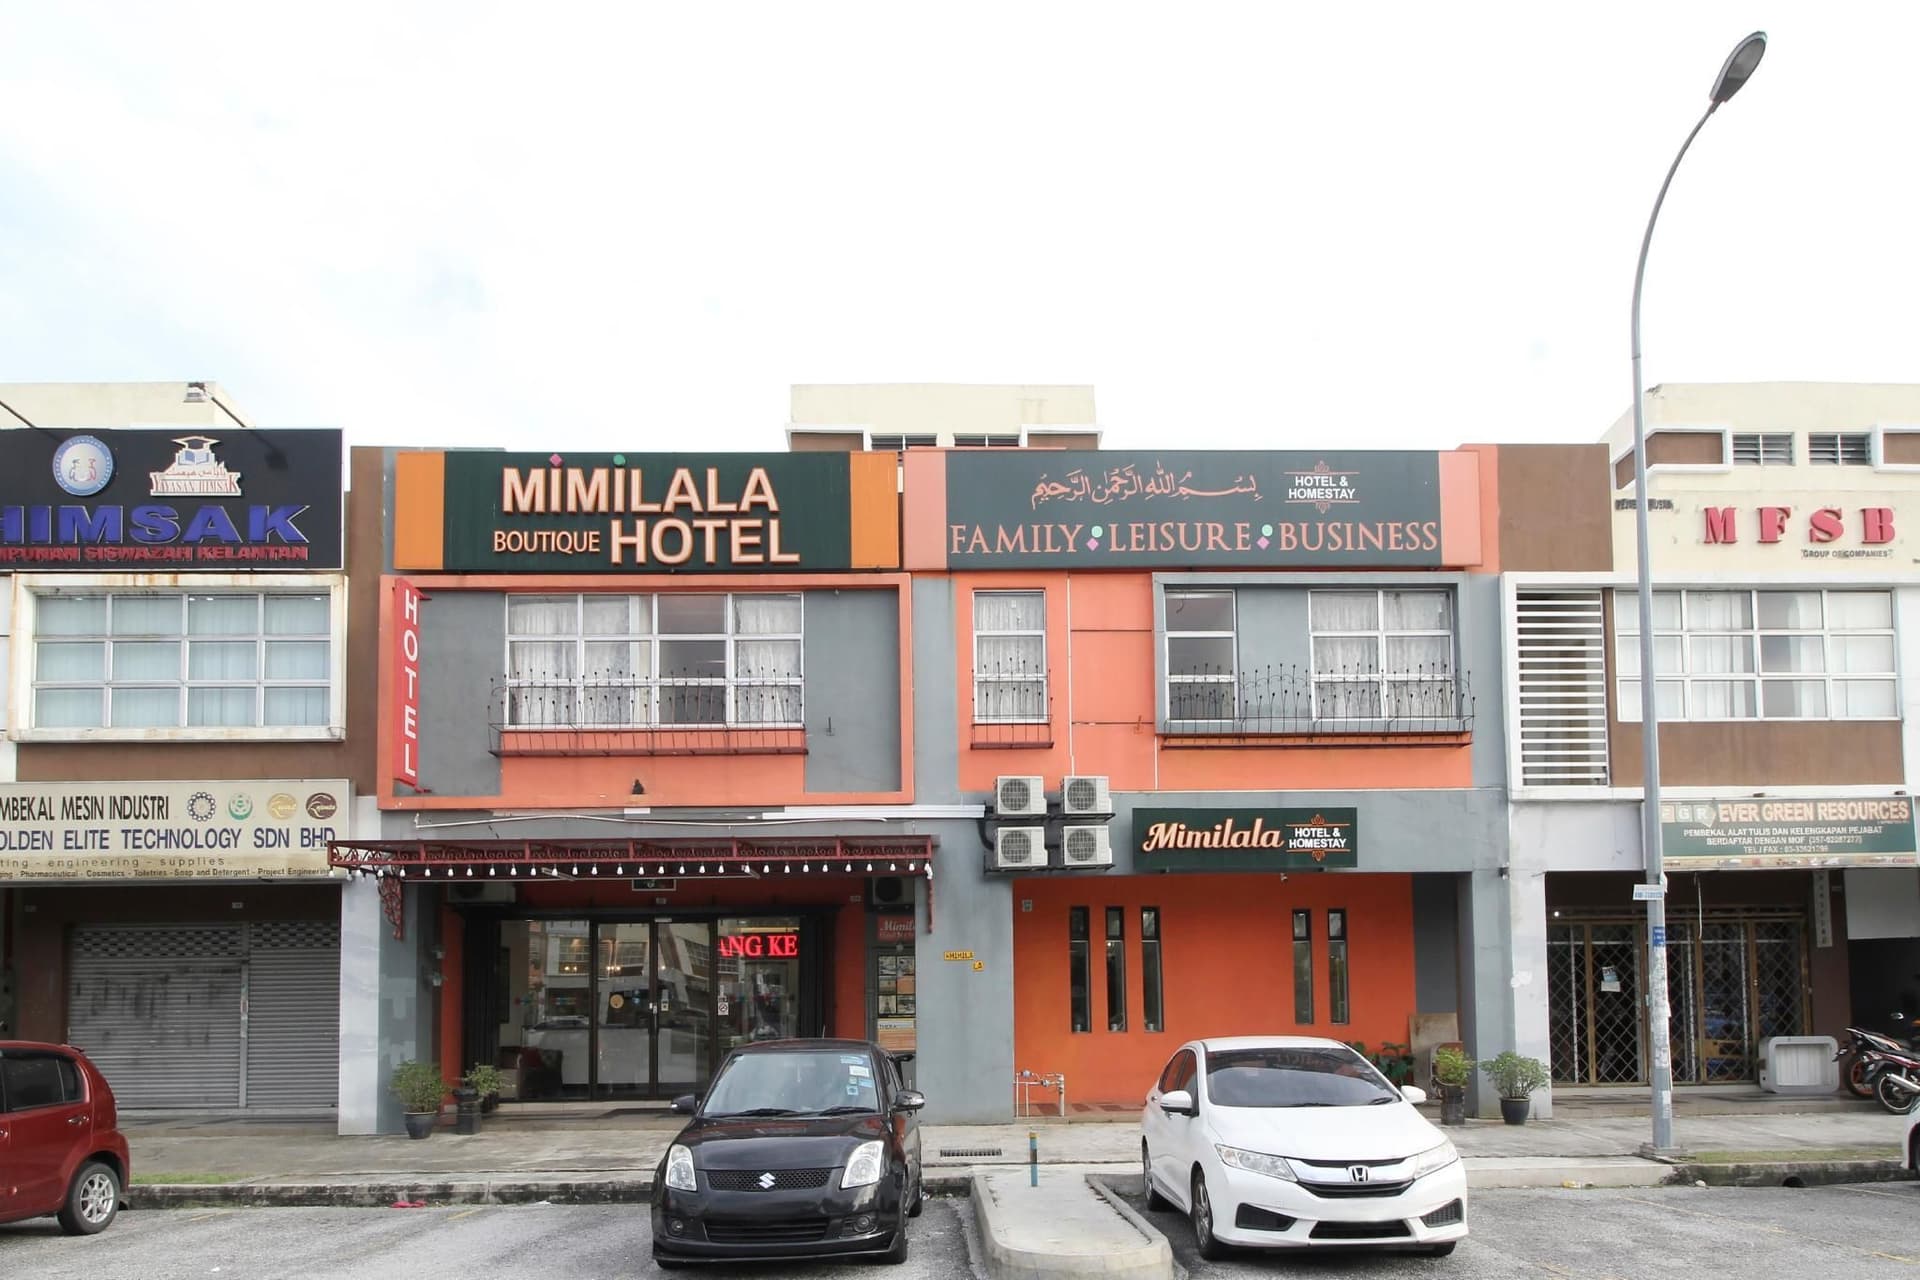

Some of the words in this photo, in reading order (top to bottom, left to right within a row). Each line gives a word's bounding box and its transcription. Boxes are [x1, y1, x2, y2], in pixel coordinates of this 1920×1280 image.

[1295, 476, 1336, 487] HOTEL
[1339, 476, 1349, 487] &
[1288, 488, 1356, 500] HOMESTAY
[493, 530, 600, 554] BOUTIQUE
[610, 518, 801, 565] HOTEL
[949, 523, 1083, 554] FAMILY
[1108, 522, 1251, 553] LEISURE
[1278, 521, 1438, 552] BUSINESS
[84, 546, 193, 561] SISWAZAH
[197, 546, 309, 561] KELANTAN
[1802, 550, 1830, 558] GROUP
[1843, 549, 1889, 558] COMPANIES
[404, 588, 418, 777] HOTEL
[61, 795, 105, 820] MESIN
[109, 795, 169, 820] INDUSTRI
[1718, 803, 1760, 823] EVER
[1762, 802, 1814, 822] GREEN
[1817, 800, 1909, 821] RESOURCES
[64, 829, 110, 850] ELITE
[121, 828, 241, 850] TECHNOLOGY
[253, 827, 290, 848] SDN
[300, 827, 336, 848] BHD
[1142, 818, 1285, 852] Mimilala
[1294, 827, 1329, 838] HOTEL
[1332, 828, 1341, 838] &
[1289, 838, 1347, 849] HOMESTAY
[47, 858, 139, 869] engineering
[160, 857, 225, 867] supplies
